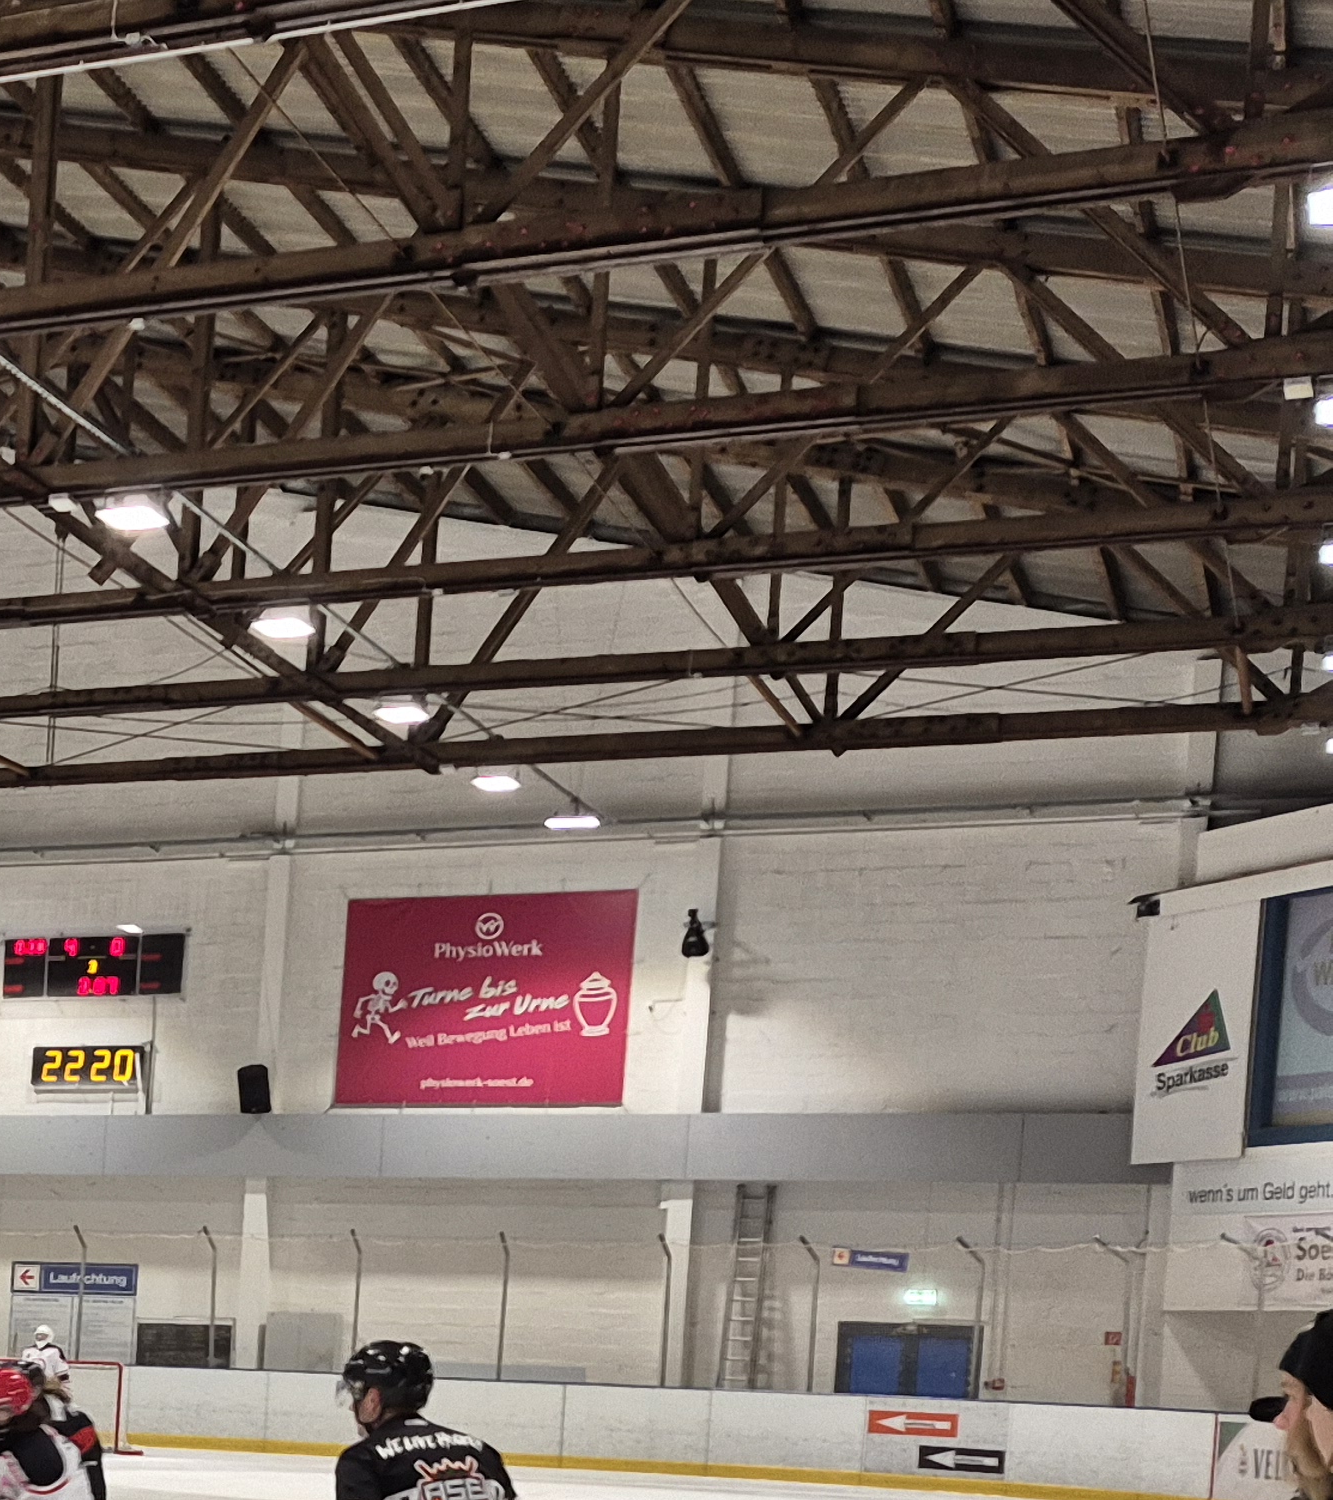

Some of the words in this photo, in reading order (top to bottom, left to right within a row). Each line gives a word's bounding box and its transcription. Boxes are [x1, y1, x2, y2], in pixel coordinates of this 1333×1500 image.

[434, 940, 543, 962] PhysioWerk
[408, 984, 474, 1009] Turne
[479, 976, 518, 999] bis
[463, 1001, 510, 1022] zur
[513, 993, 570, 1016] Urne
[509, 1021, 551, 1038] Leben
[1175, 1027, 1220, 1058] Club
[1155, 1061, 1230, 1092] Sparkasse
[1237, 1187, 1259, 1202] um
[1263, 1181, 1296, 1201] Geld
[1296, 1237, 1333, 1262] Soe
